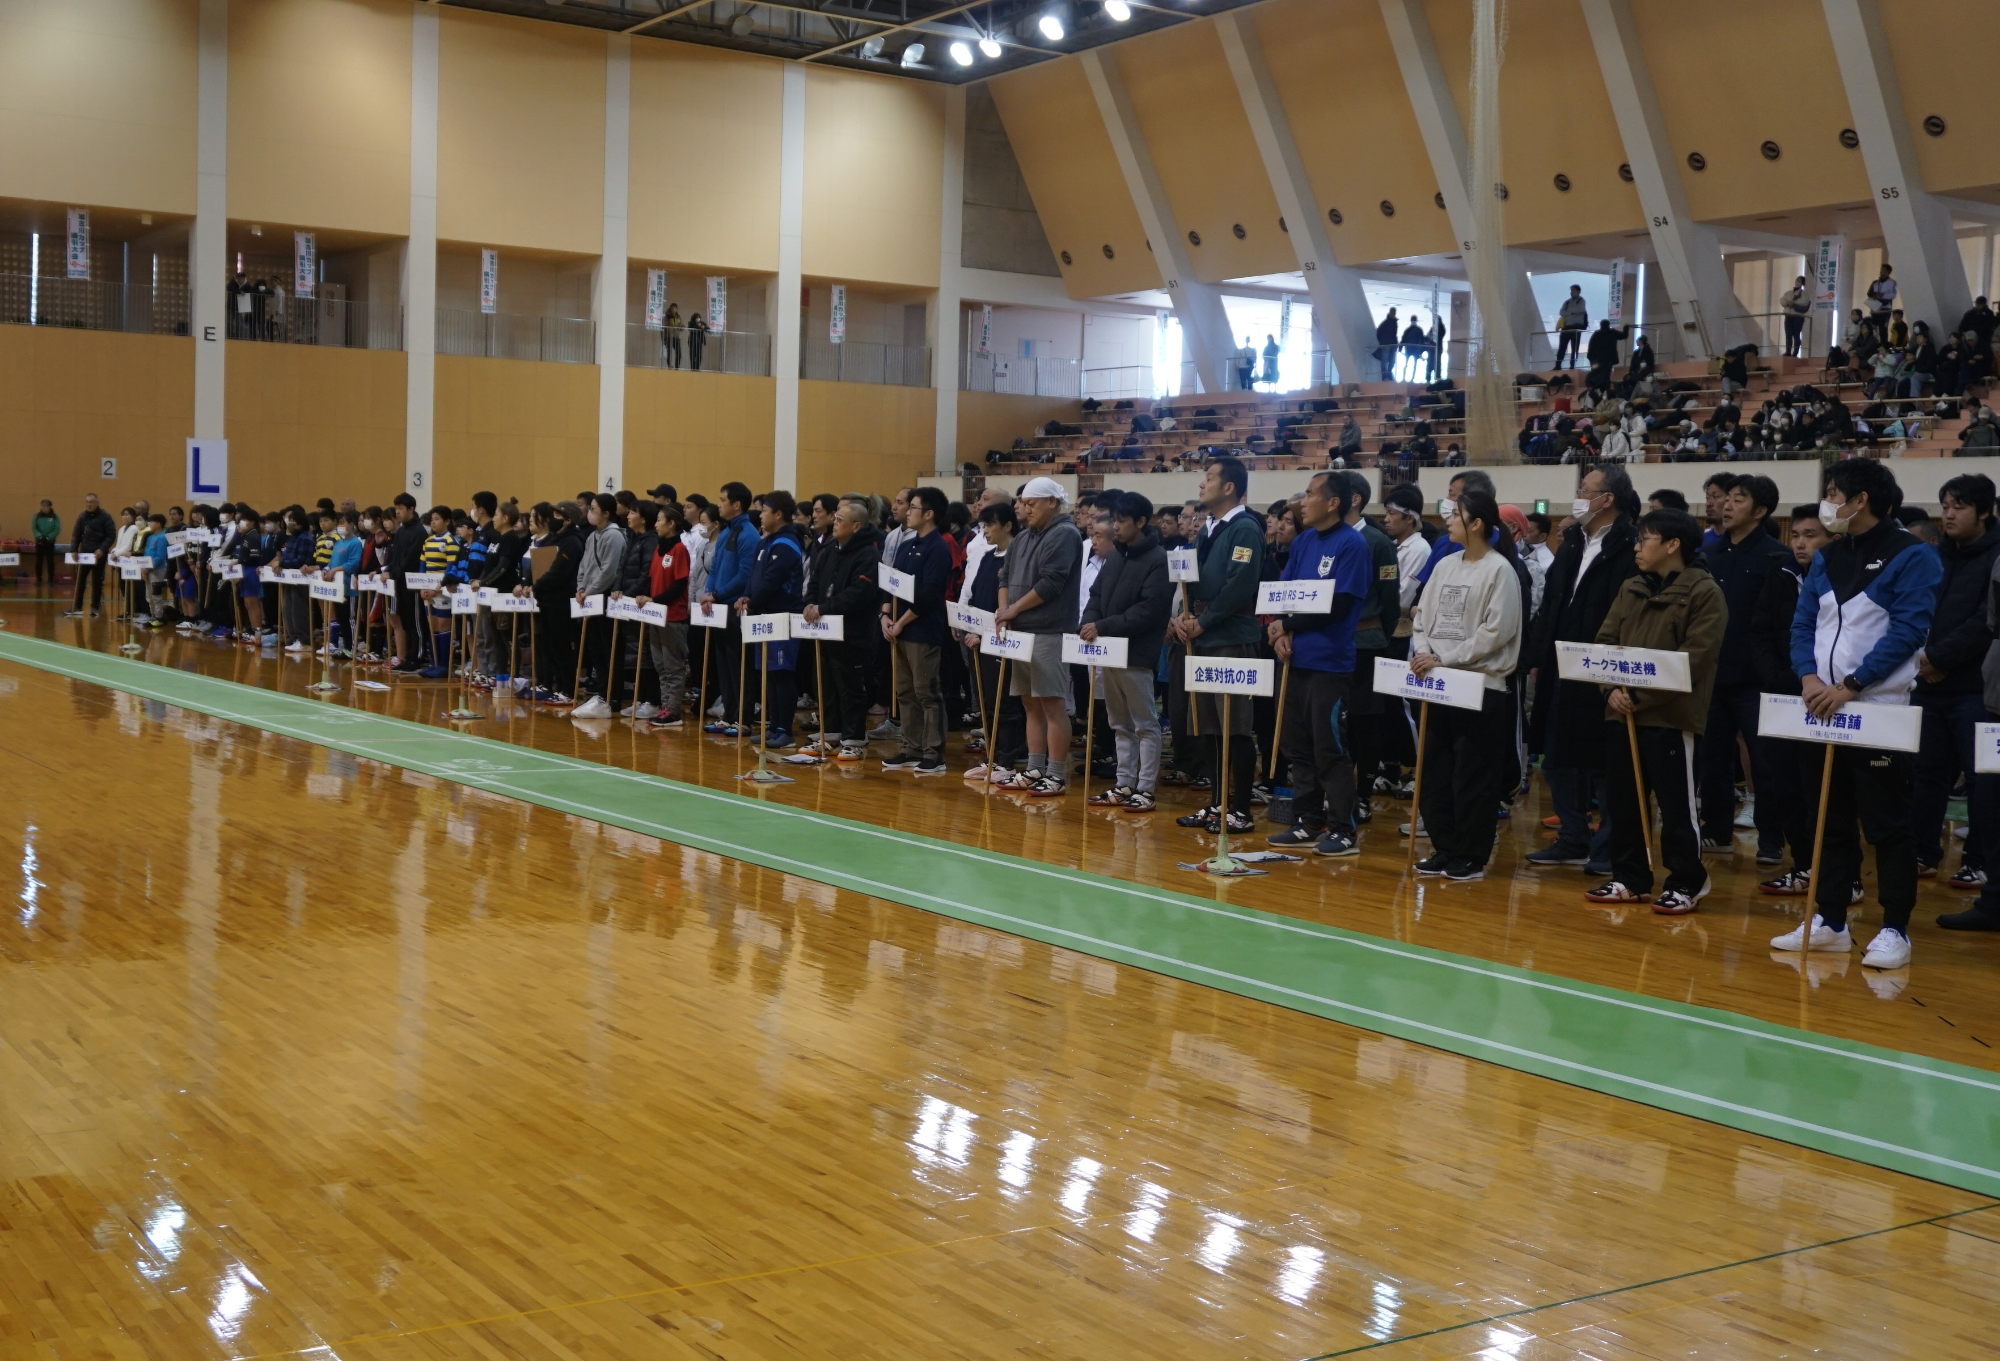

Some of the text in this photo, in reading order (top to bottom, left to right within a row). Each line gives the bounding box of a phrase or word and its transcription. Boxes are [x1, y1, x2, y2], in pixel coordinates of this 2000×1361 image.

[1881, 187, 1899, 199] S5
[1653, 216, 1669, 227] S4
[1304, 261, 1317, 271] S2
[1168, 279, 1179, 288] S1
[204, 326, 217, 341] E
[103, 460, 113, 476] 2
[192, 447, 219, 493] L
[413, 472, 422, 486] 3
[605, 477, 614, 491] 4
[751, 623, 774, 636] 男子の部
[1582, 656, 1657, 676] オークラ輸送機
[1194, 666, 1258, 686] 企業対抗の部
[1804, 711, 1863, 731] 松竹酒舗
